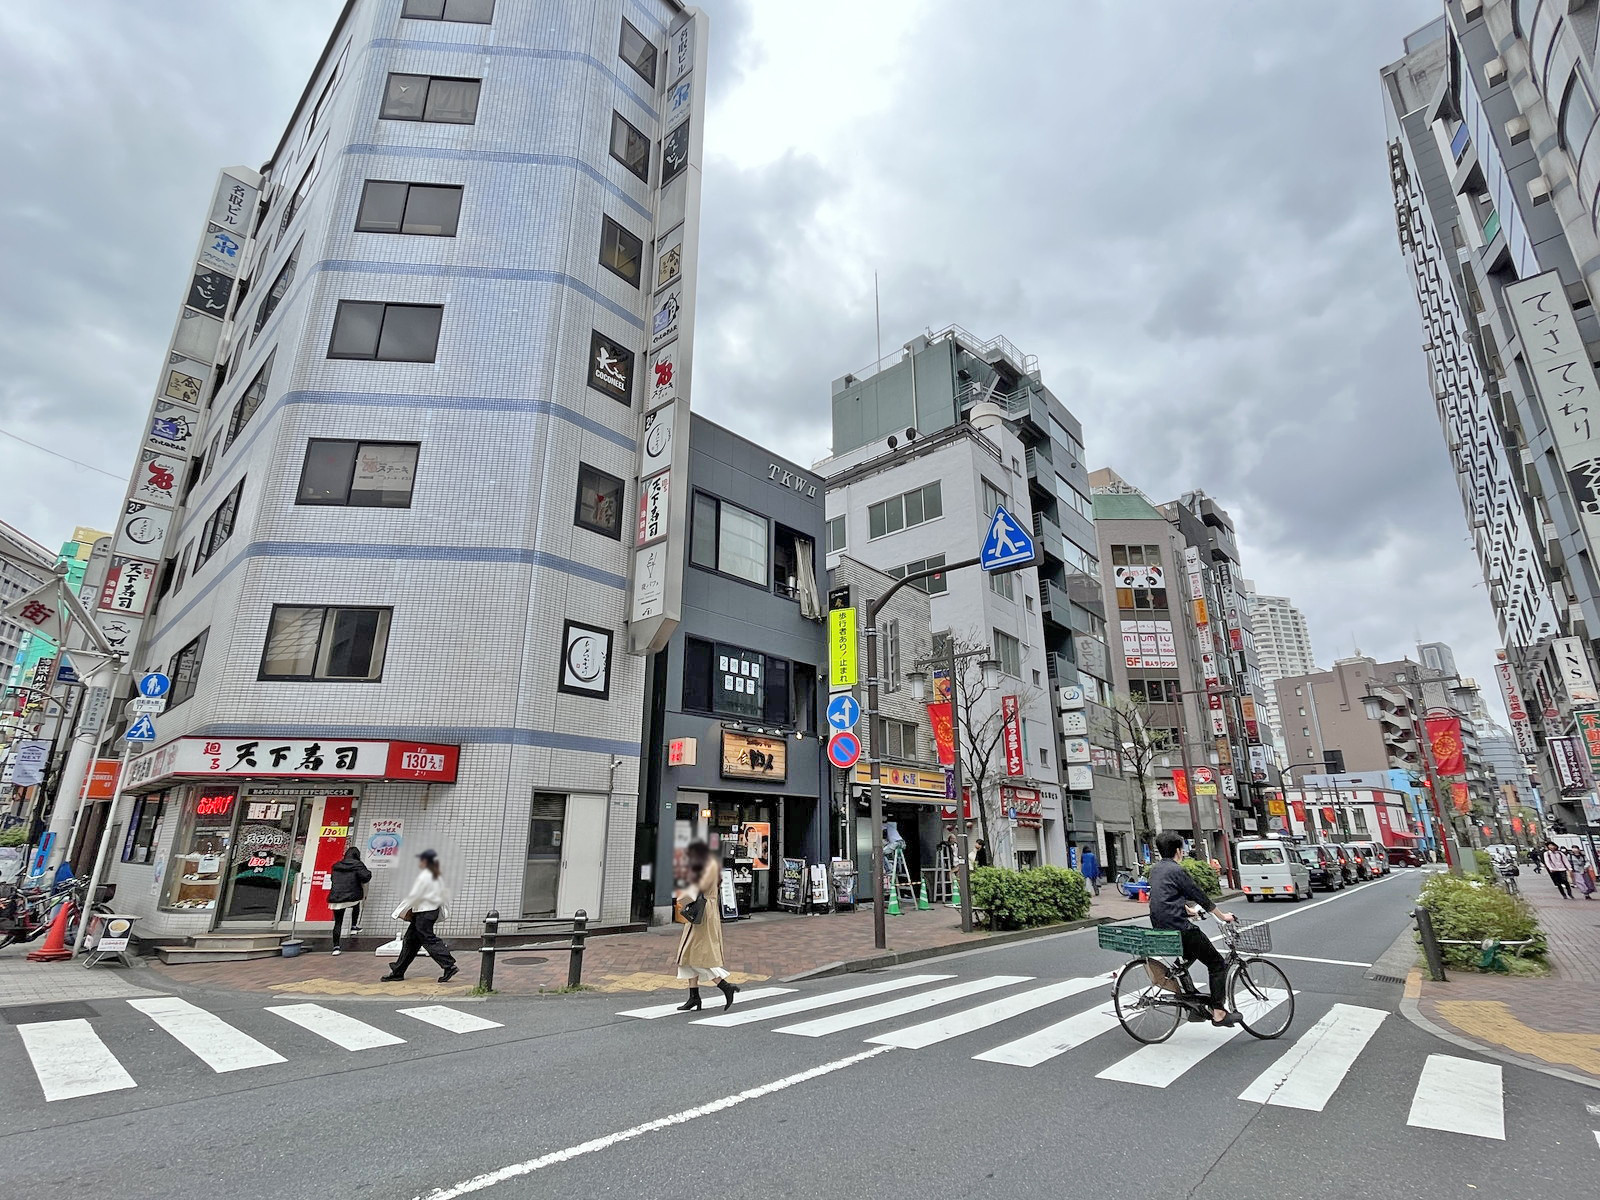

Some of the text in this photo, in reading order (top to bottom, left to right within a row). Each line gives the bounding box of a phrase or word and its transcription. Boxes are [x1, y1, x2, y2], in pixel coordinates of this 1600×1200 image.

[676, 28, 690, 78] 名取ビル
[224, 185, 245, 225] 名取ビル
[1521, 291, 1590, 440] てっさ てっちり
[140, 485, 173, 498] ステーキ
[129, 503, 141, 513] 2F
[648, 478, 661, 537] 天下寿司
[118, 563, 144, 609] 天下寿司
[19, 600, 55, 626] 街
[1127, 657, 1141, 666] 5F
[203, 741, 222, 770] 廻る
[226, 741, 358, 772] 天下寿司
[406, 754, 427, 769] 130
[323, 827, 336, 836] 130
